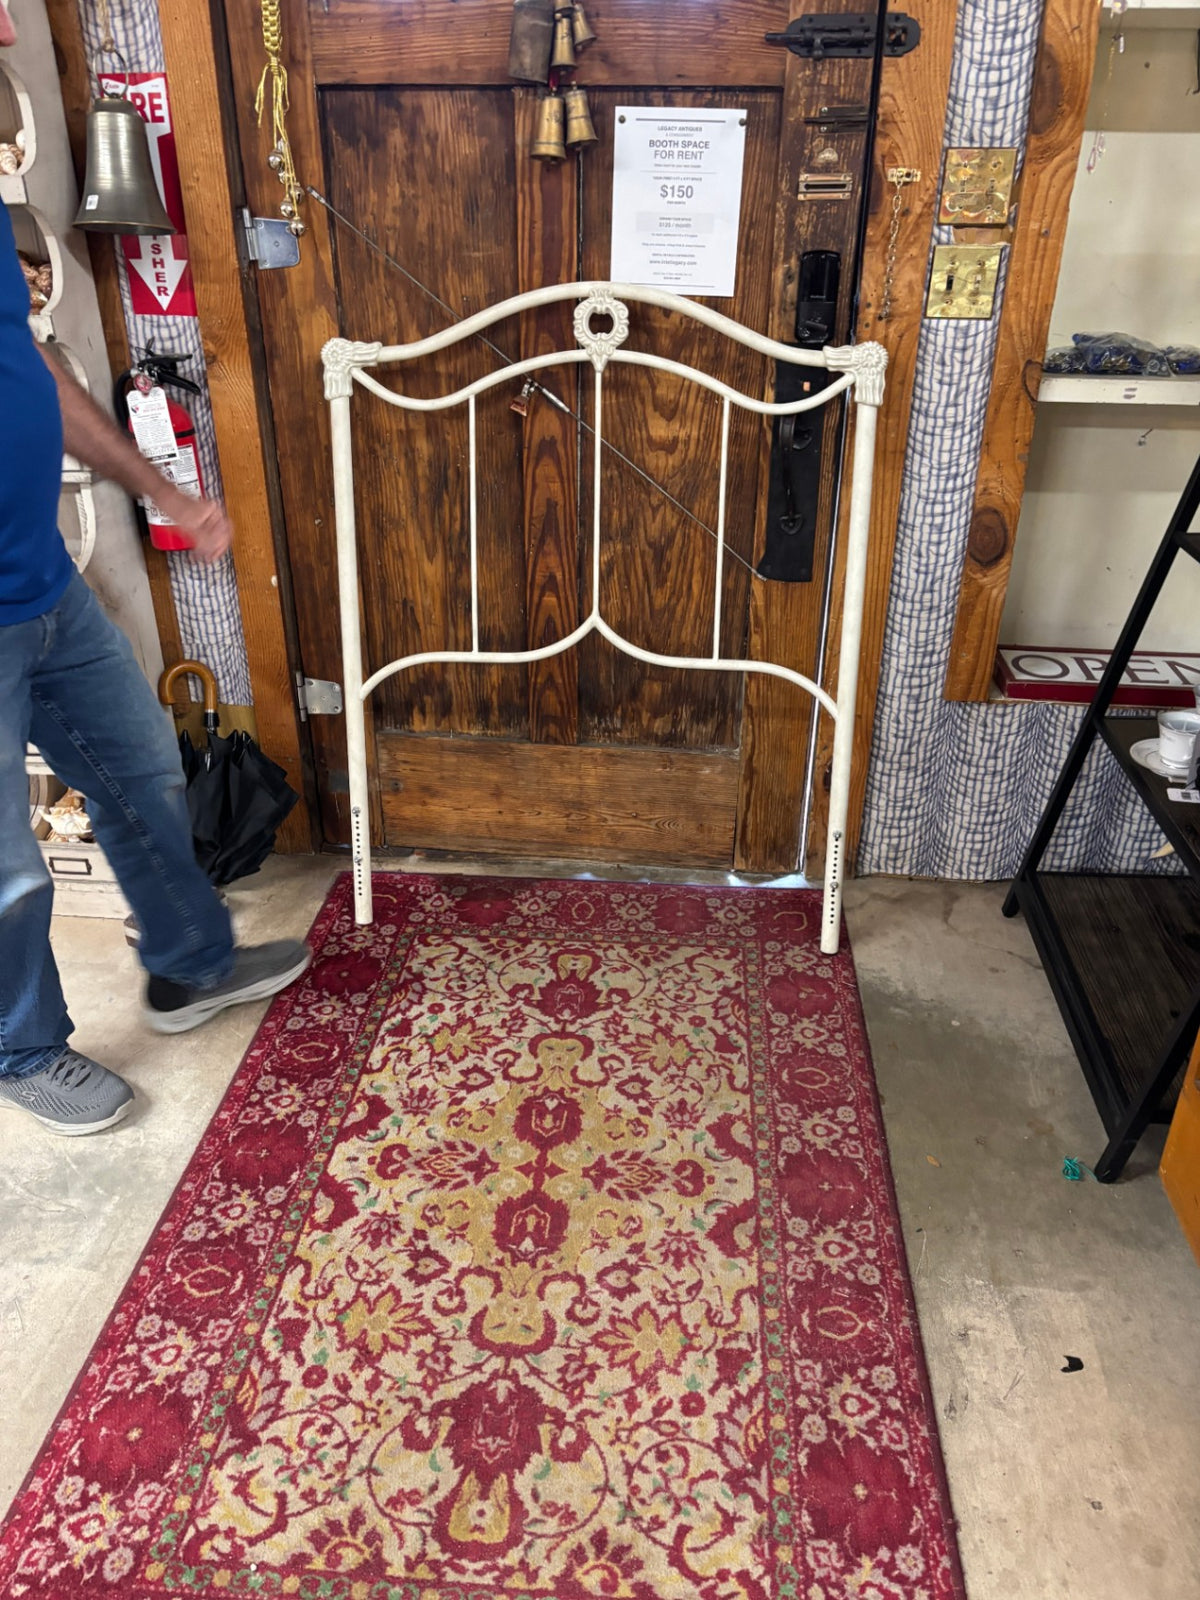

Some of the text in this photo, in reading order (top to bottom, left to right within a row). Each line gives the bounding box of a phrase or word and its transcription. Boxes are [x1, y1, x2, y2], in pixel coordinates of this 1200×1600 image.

[649, 139, 710, 149] BOOTH SPACE
[654, 150, 704, 160] FOR RENT
[660, 184, 694, 199] $150
